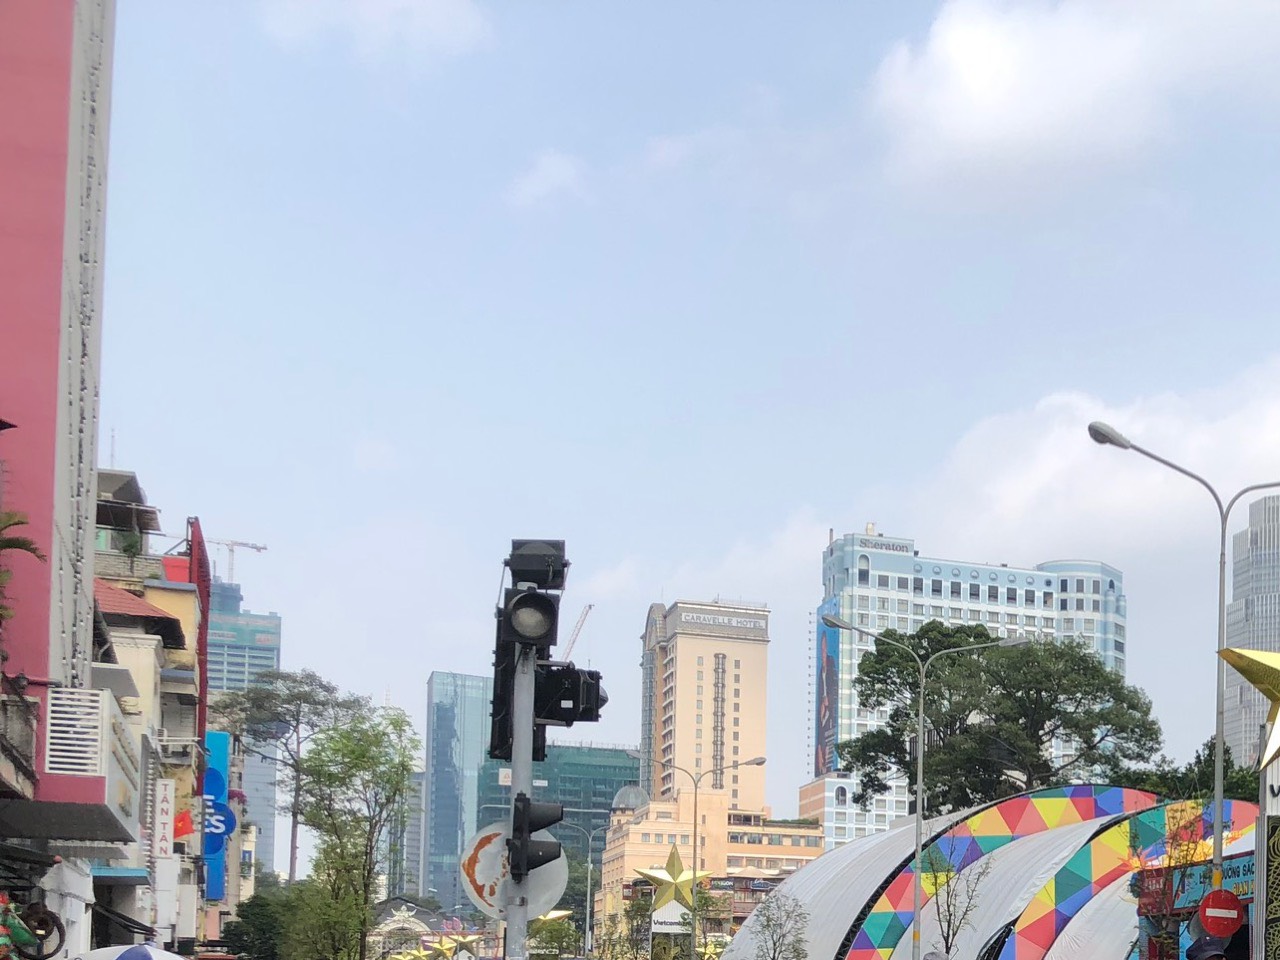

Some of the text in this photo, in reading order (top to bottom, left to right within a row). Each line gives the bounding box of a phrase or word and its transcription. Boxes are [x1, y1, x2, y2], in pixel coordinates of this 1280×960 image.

[859, 538, 909, 553] Sheraton
[684, 614, 763, 628] CARAVELLE HOTEL
